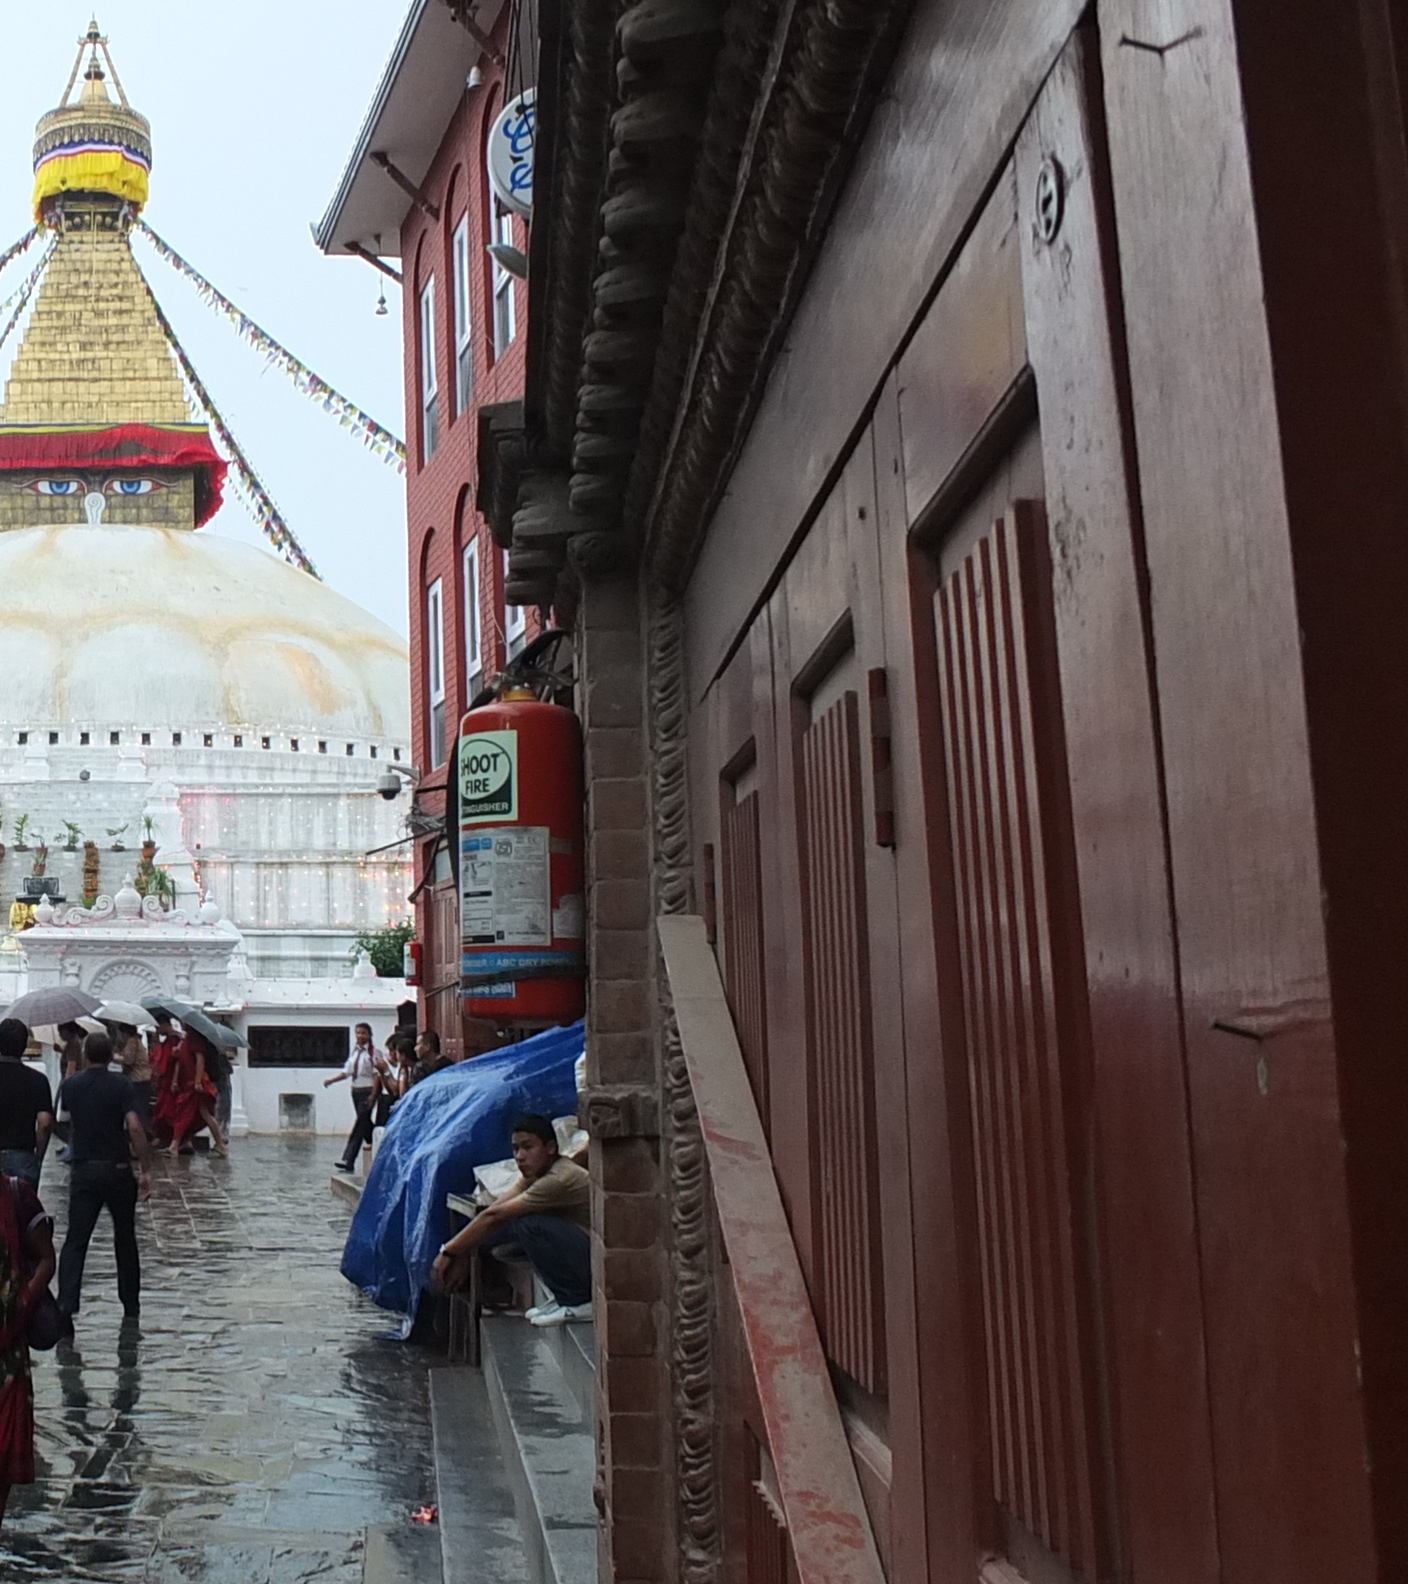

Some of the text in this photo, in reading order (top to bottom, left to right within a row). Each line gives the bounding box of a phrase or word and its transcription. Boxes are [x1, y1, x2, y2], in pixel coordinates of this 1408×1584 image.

[465, 777, 490, 795] FIRE
[496, 958, 516, 967] ABC
[518, 958, 540, 967] DRY
